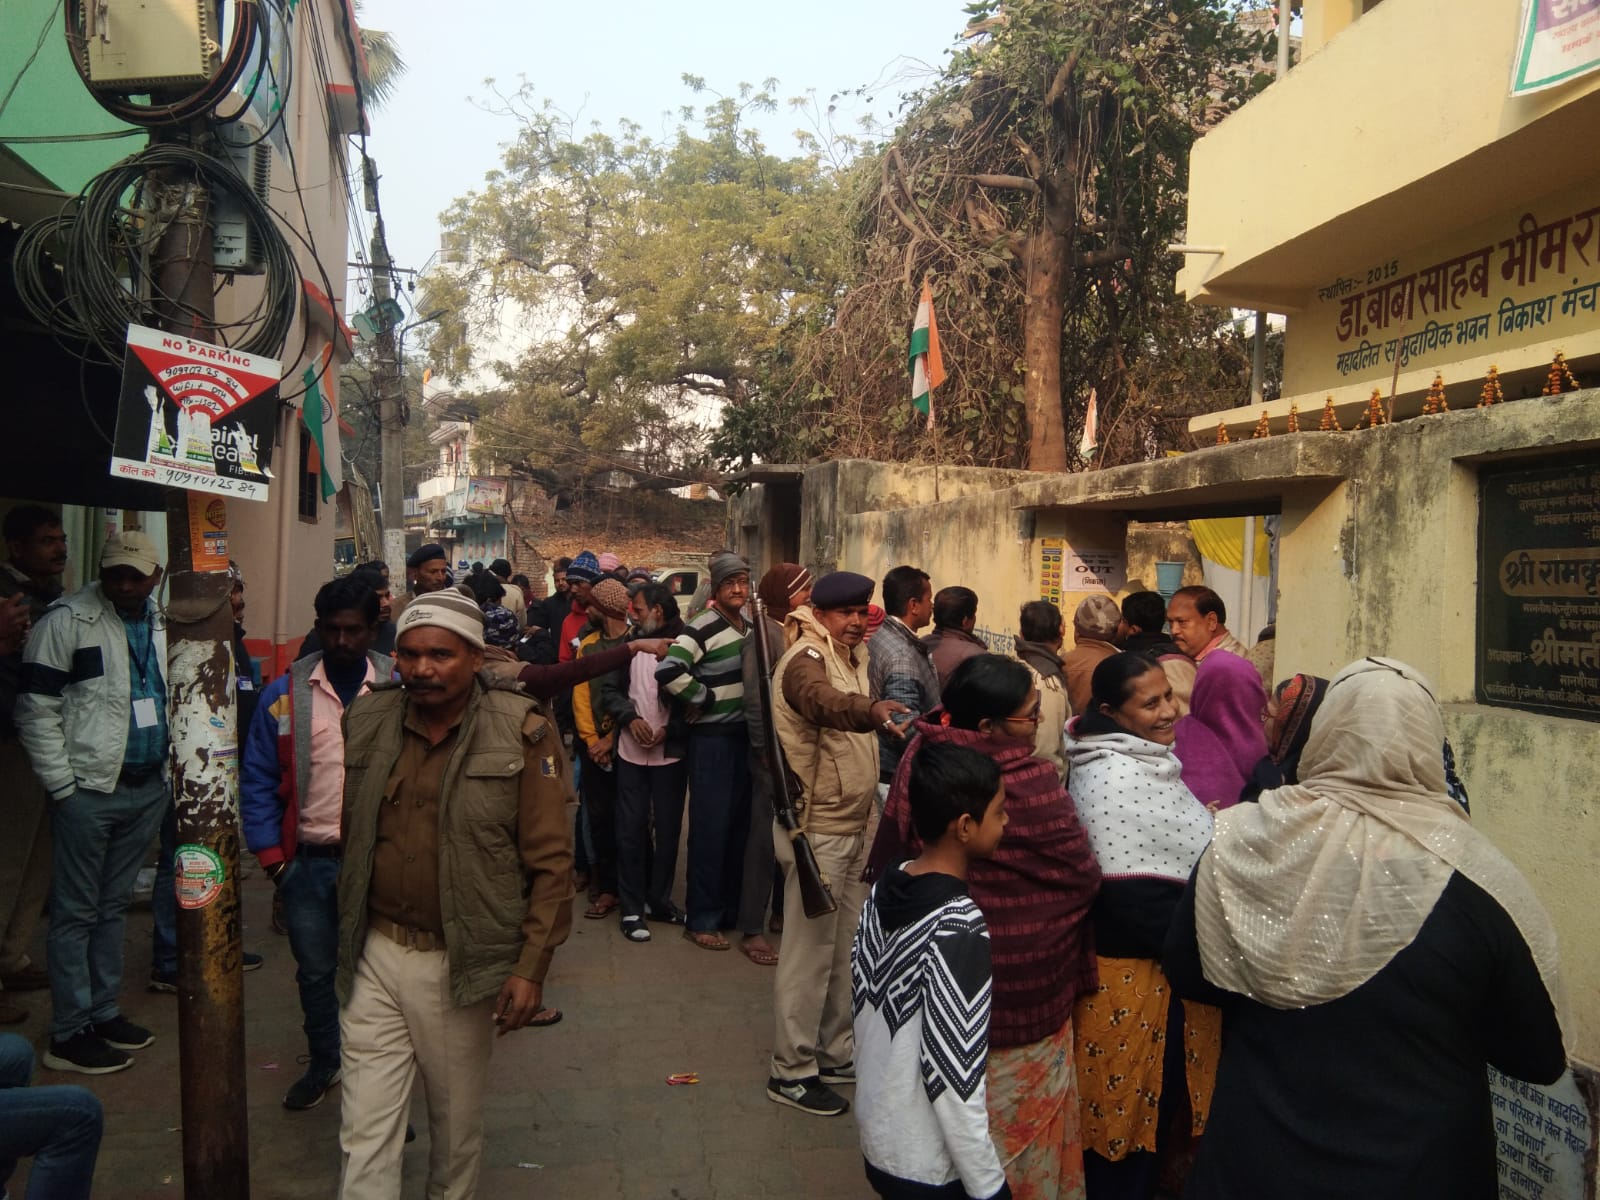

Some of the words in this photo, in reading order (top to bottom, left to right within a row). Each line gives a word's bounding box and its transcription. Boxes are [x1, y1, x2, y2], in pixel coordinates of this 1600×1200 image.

[1366, 259, 1399, 285] 2015
[1456, 313, 1493, 348] भवन
[162, 337, 184, 351] NO
[188, 344, 251, 367] PARKING
[119, 463, 139, 477] कॉल
[1075, 565, 1115, 574] OUT
[1505, 551, 1535, 590] श्री
